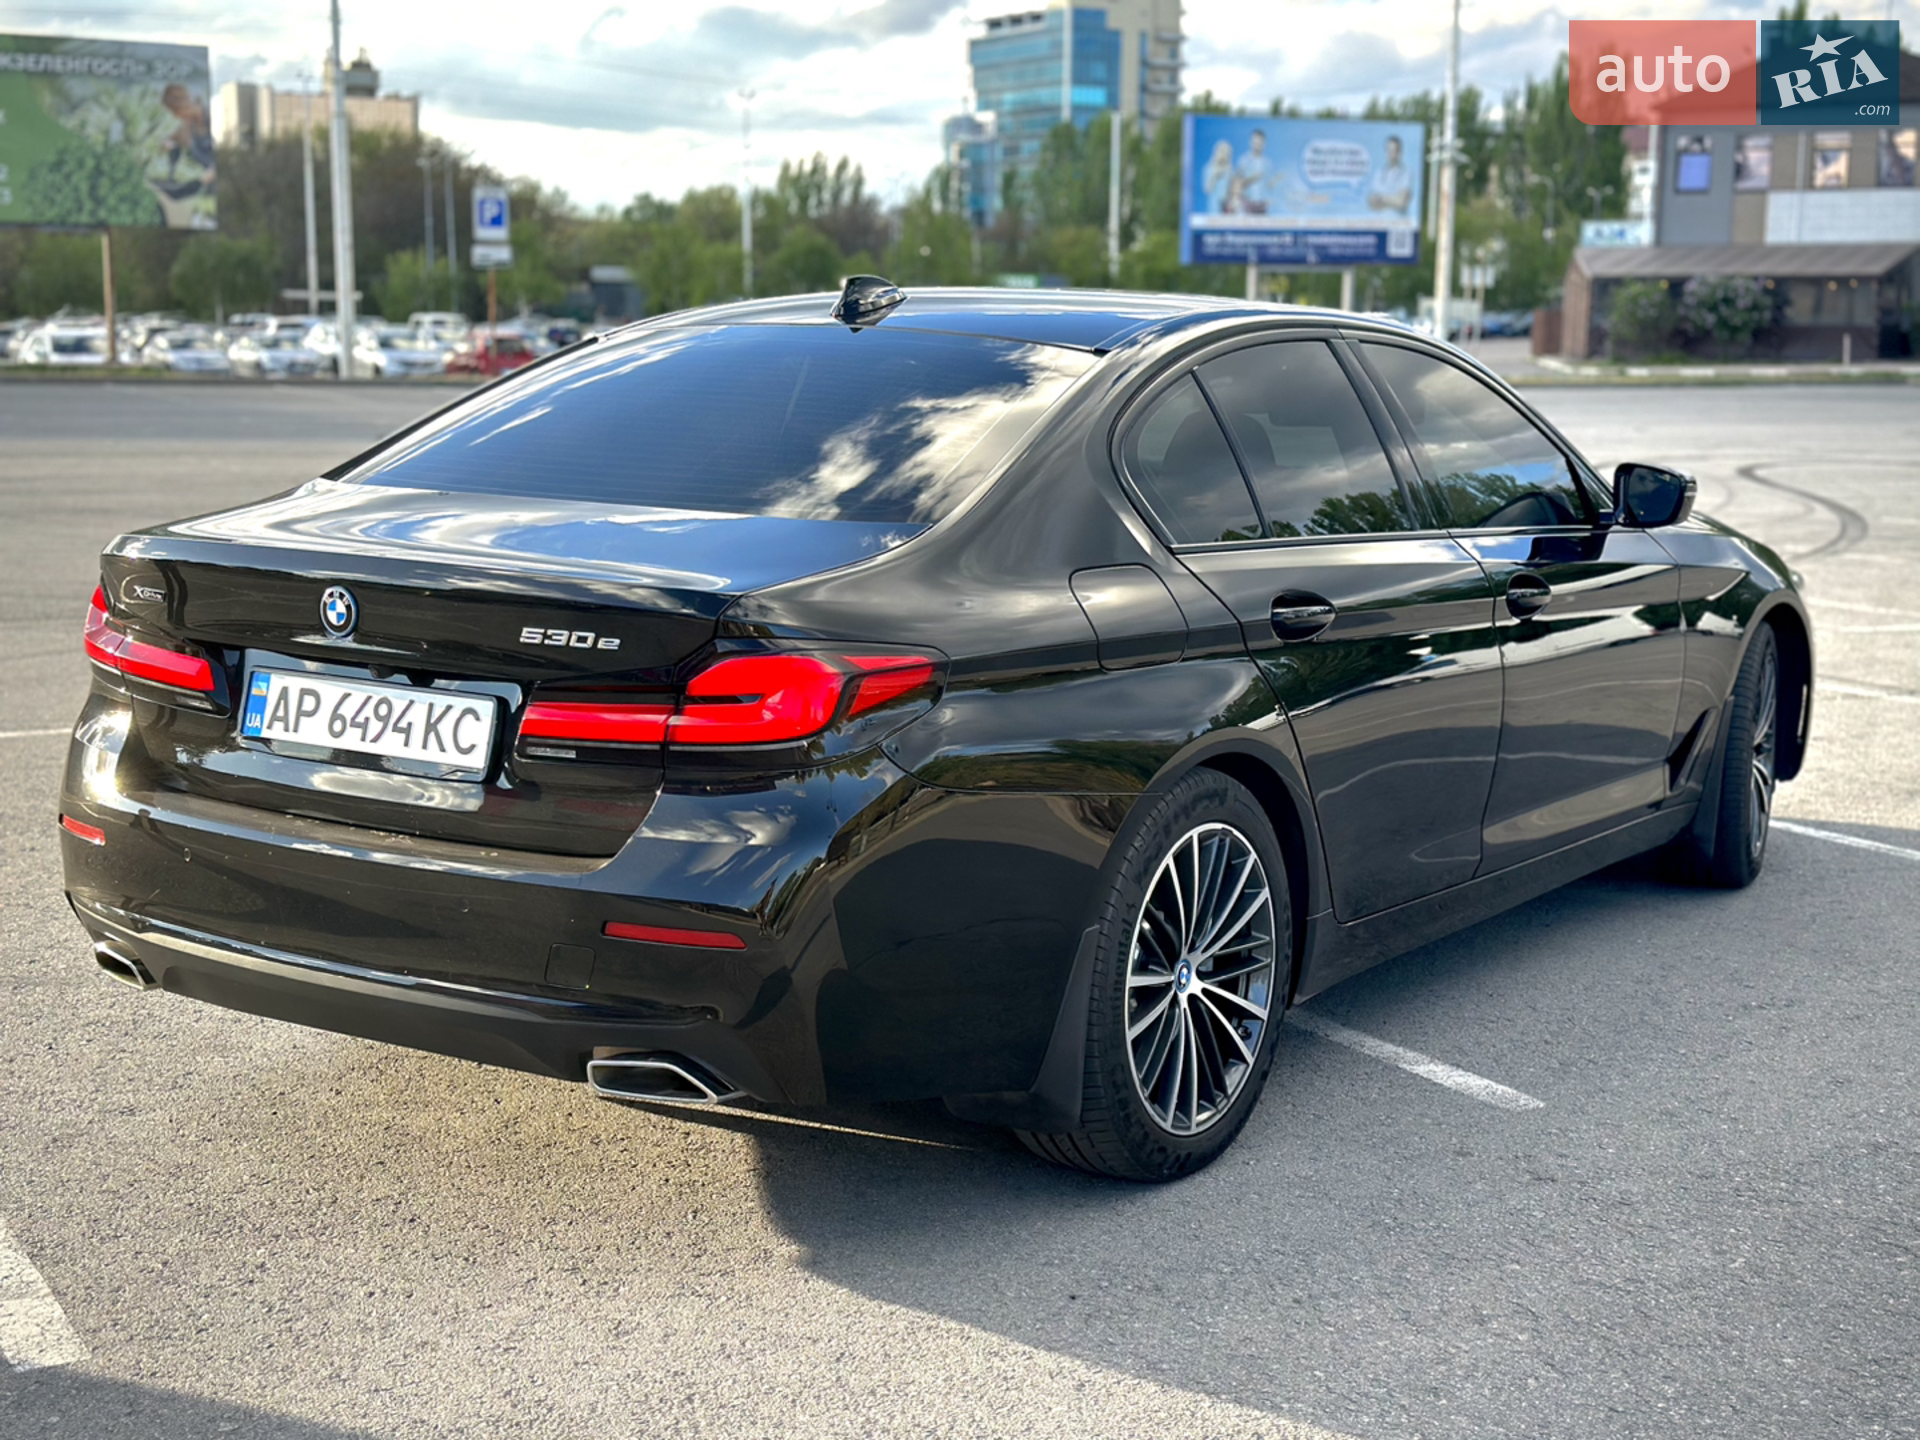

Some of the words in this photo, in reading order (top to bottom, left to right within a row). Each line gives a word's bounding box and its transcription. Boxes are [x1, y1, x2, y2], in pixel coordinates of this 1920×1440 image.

[484, 202, 500, 226] P
[519, 627, 621, 650] 530e
[247, 713, 261, 729] UA
[266, 686, 321, 733] AP
[328, 693, 415, 747] 6494
[422, 702, 481, 755] KC
